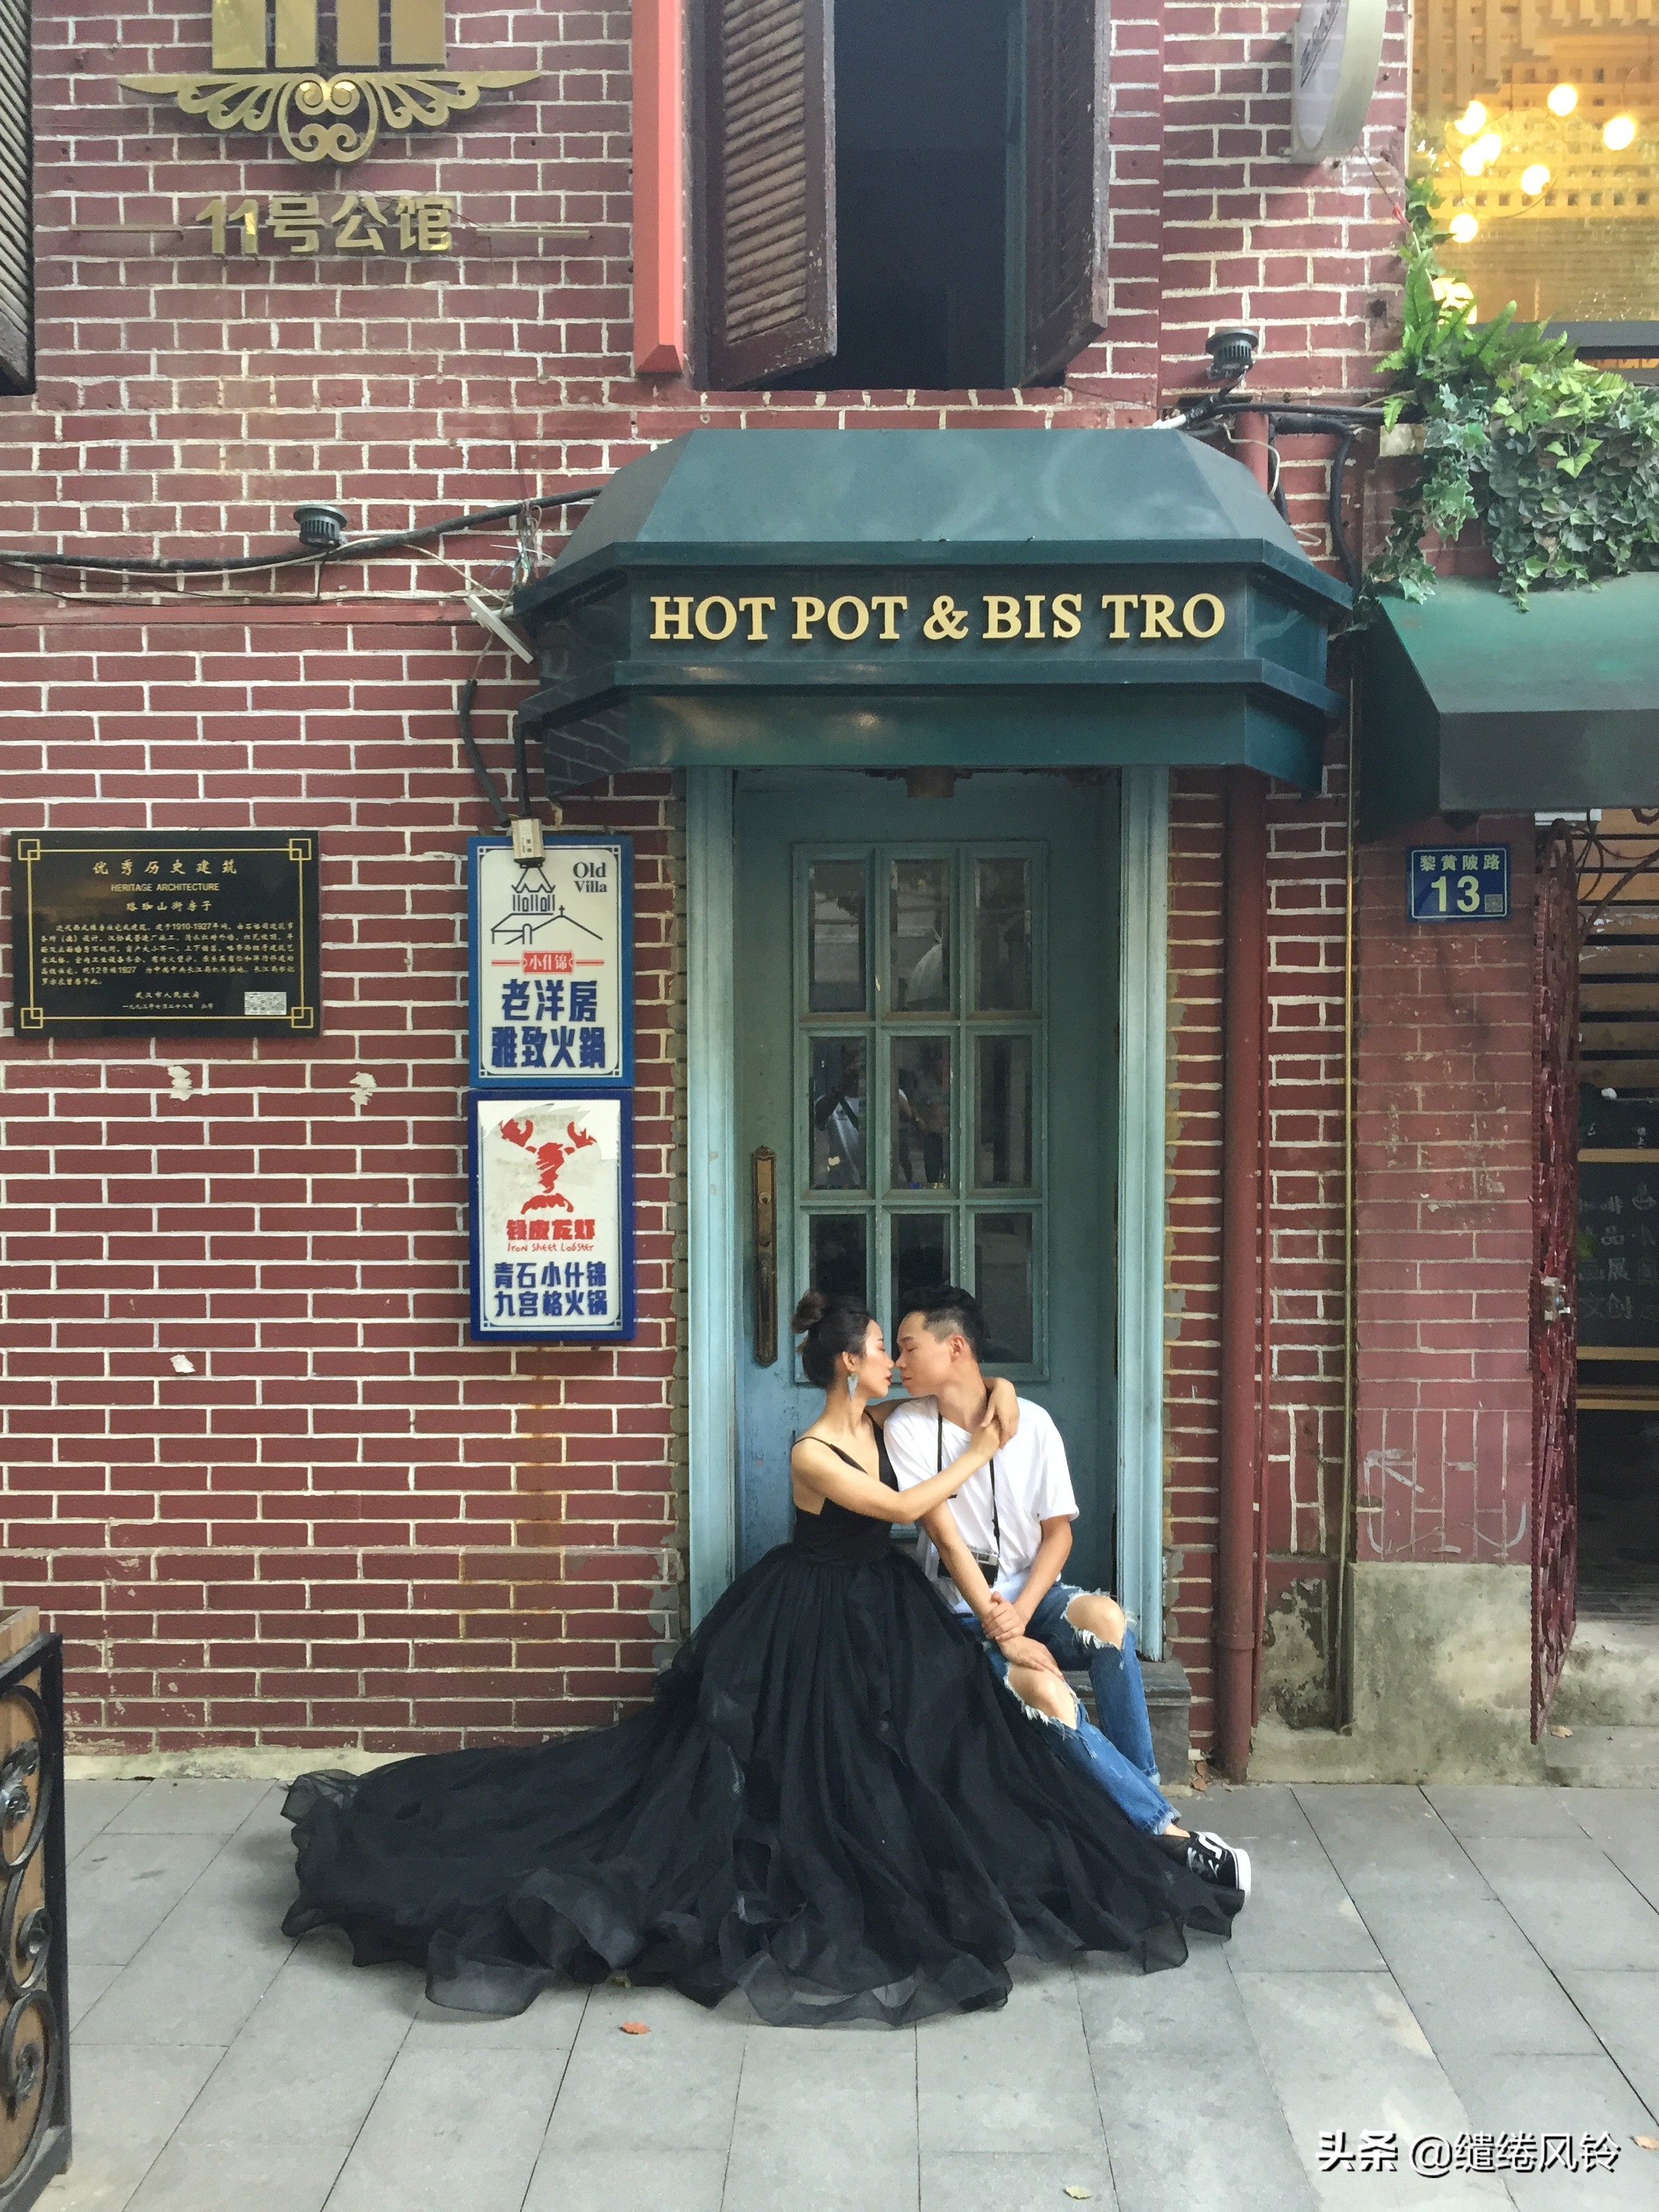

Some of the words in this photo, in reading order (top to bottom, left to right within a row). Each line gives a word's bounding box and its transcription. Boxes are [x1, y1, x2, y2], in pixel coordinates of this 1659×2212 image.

[195, 195, 453, 254] 11号公馆
[649, 596, 776, 640] HOT
[790, 594, 907, 641] POT
[922, 594, 970, 641] &
[93, 859, 237, 876] 优秀历史建筑
[573, 862, 607, 878] Old
[1419, 853, 1500, 872] 黎黄陂路
[110, 882, 152, 893] HERITAGE
[156, 882, 220, 892] ARCHITECTURE
[574, 880, 607, 893] Villa
[1431, 875, 1480, 912] 13
[501, 979, 598, 1022] 老洋房
[506, 1219, 596, 1241] 铁皮龙虾
[494, 1261, 607, 1288] 青石小什锦
[494, 1290, 608, 1317] 九宫格火锅
